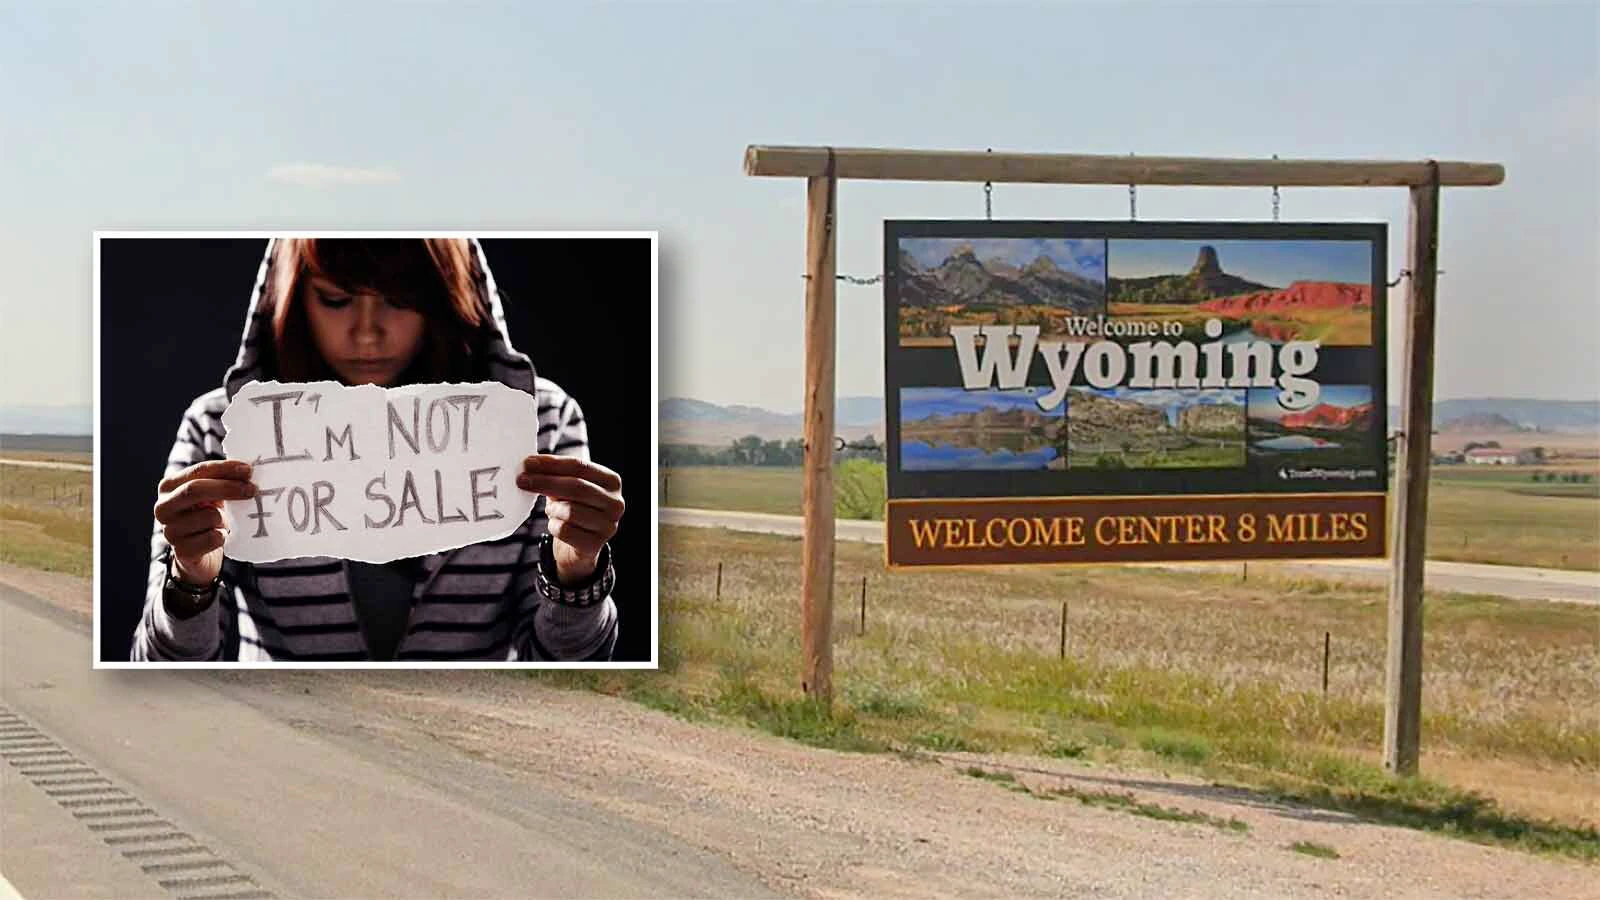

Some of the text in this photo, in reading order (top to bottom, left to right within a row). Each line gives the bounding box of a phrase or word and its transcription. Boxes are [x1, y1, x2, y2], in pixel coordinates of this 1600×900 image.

[1064, 317, 1183, 336] Welcome to
[950, 318, 1321, 411] Wyoming
[387, 395, 488, 460] NOT
[247, 466, 504, 538] FOR SALE
[910, 512, 1368, 549] WELCOME CENTER 8 MILES
